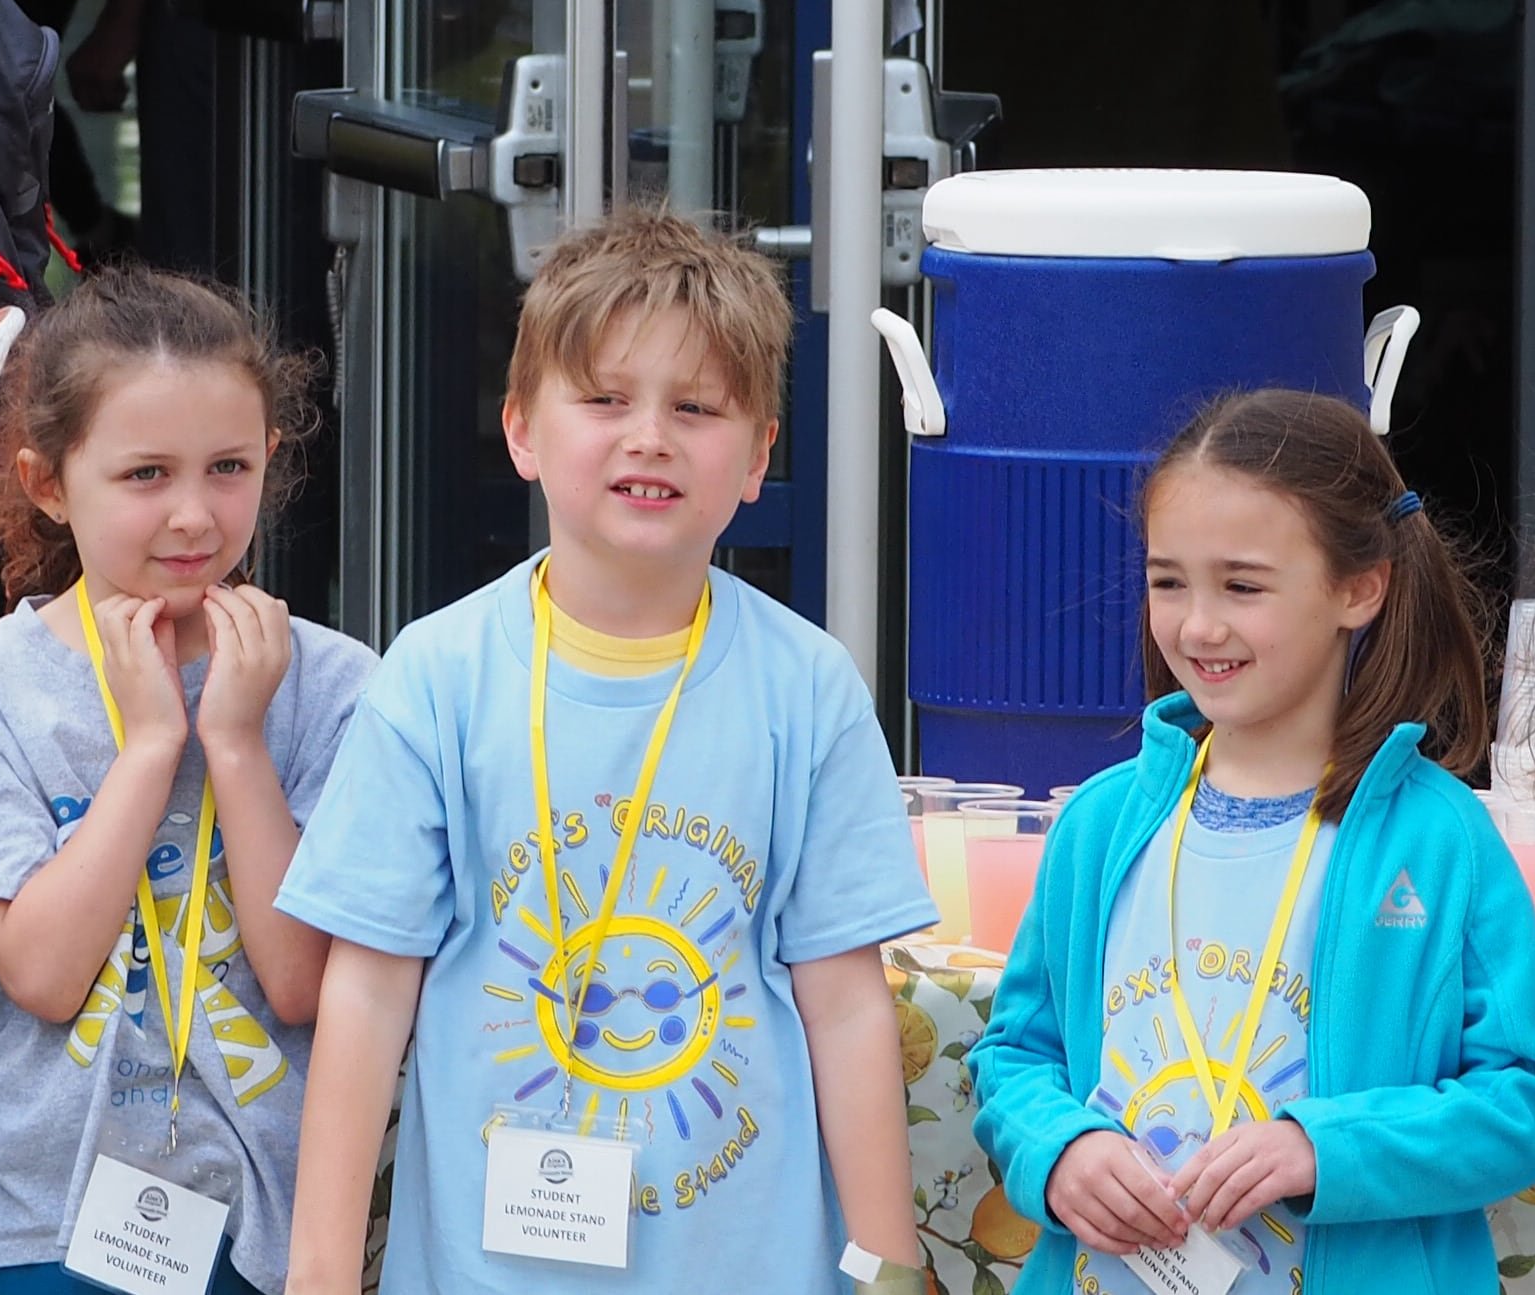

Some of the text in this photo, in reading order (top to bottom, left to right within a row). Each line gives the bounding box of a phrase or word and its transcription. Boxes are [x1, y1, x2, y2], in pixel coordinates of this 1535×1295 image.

[1374, 915, 1428, 928] GERRY
[674, 1106, 761, 1210] Stand
[530, 1188, 582, 1206] STUDENT
[504, 1203, 606, 1227] LEMONADE STAND
[122, 1220, 172, 1248] STUDENT
[521, 1223, 587, 1243] VOLUNTEER
[93, 1228, 190, 1275] LEMONADE STAND
[105, 1253, 168, 1287] VOLUNTEER
[1169, 1264, 1200, 1295] STAND
